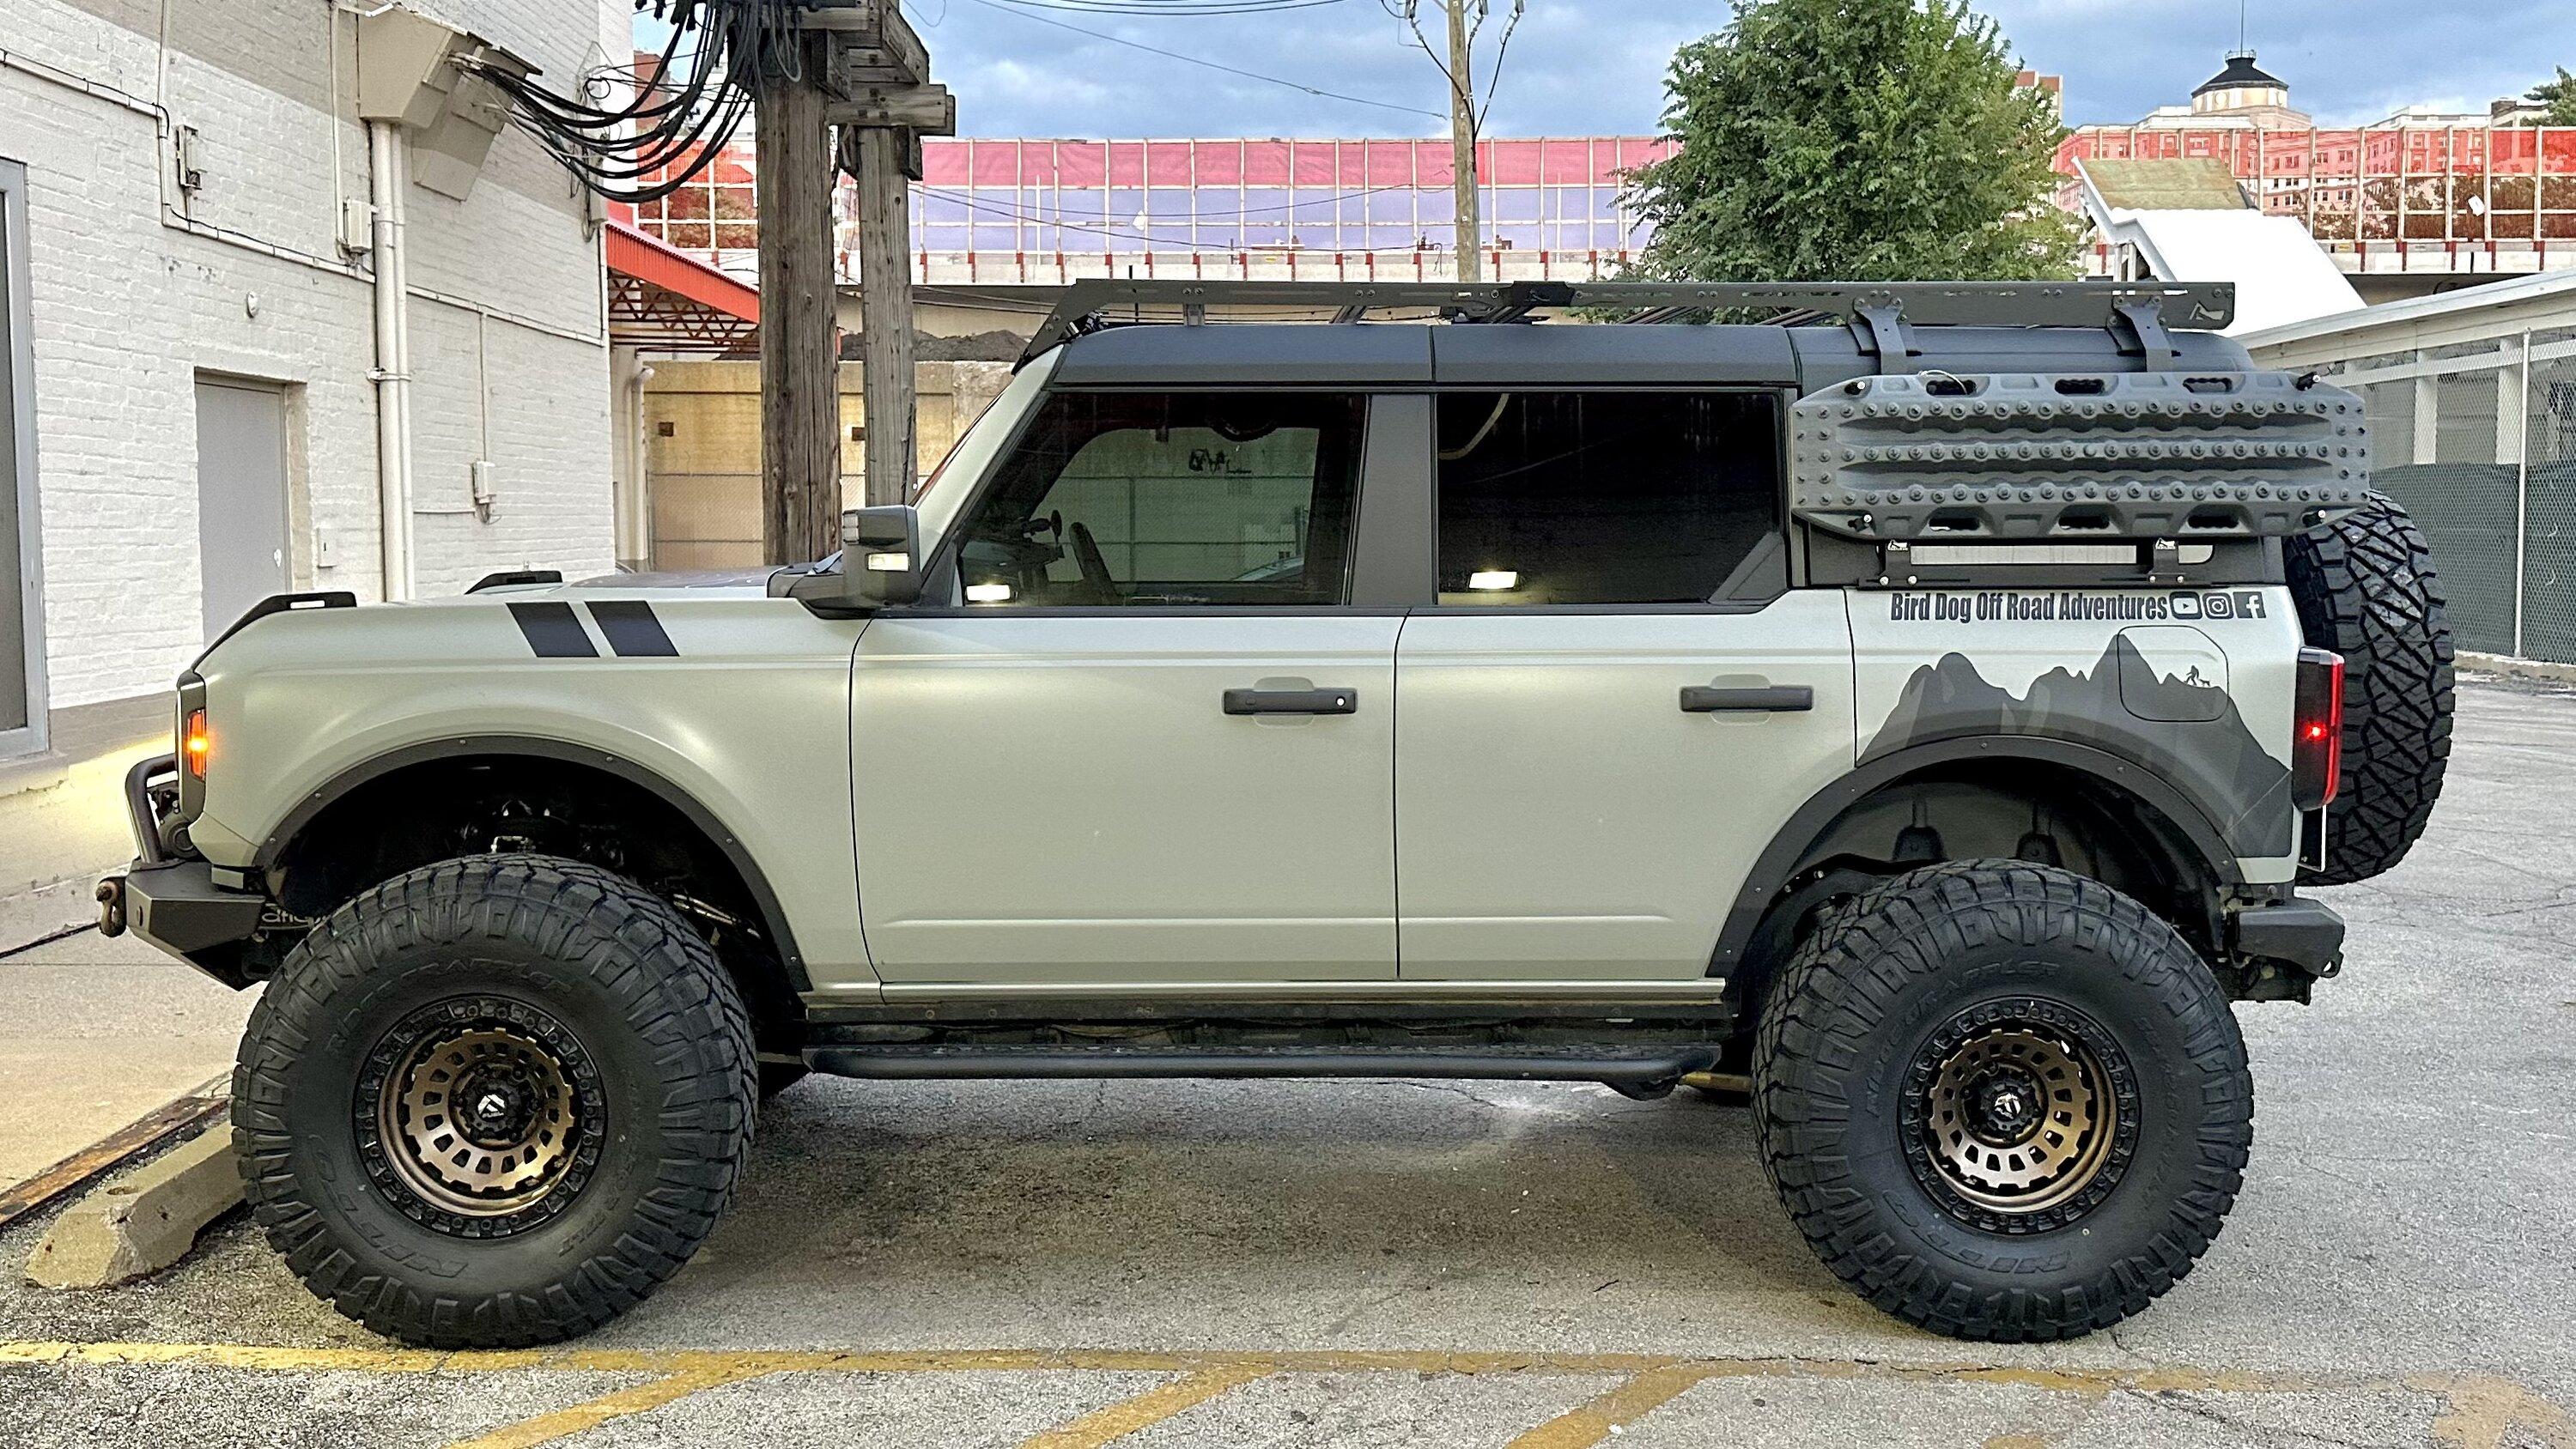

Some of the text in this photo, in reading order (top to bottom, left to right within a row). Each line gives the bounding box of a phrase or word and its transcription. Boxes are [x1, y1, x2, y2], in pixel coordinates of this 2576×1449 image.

[1891, 592, 2167, 623] Bird Dog Off Road Adventures
